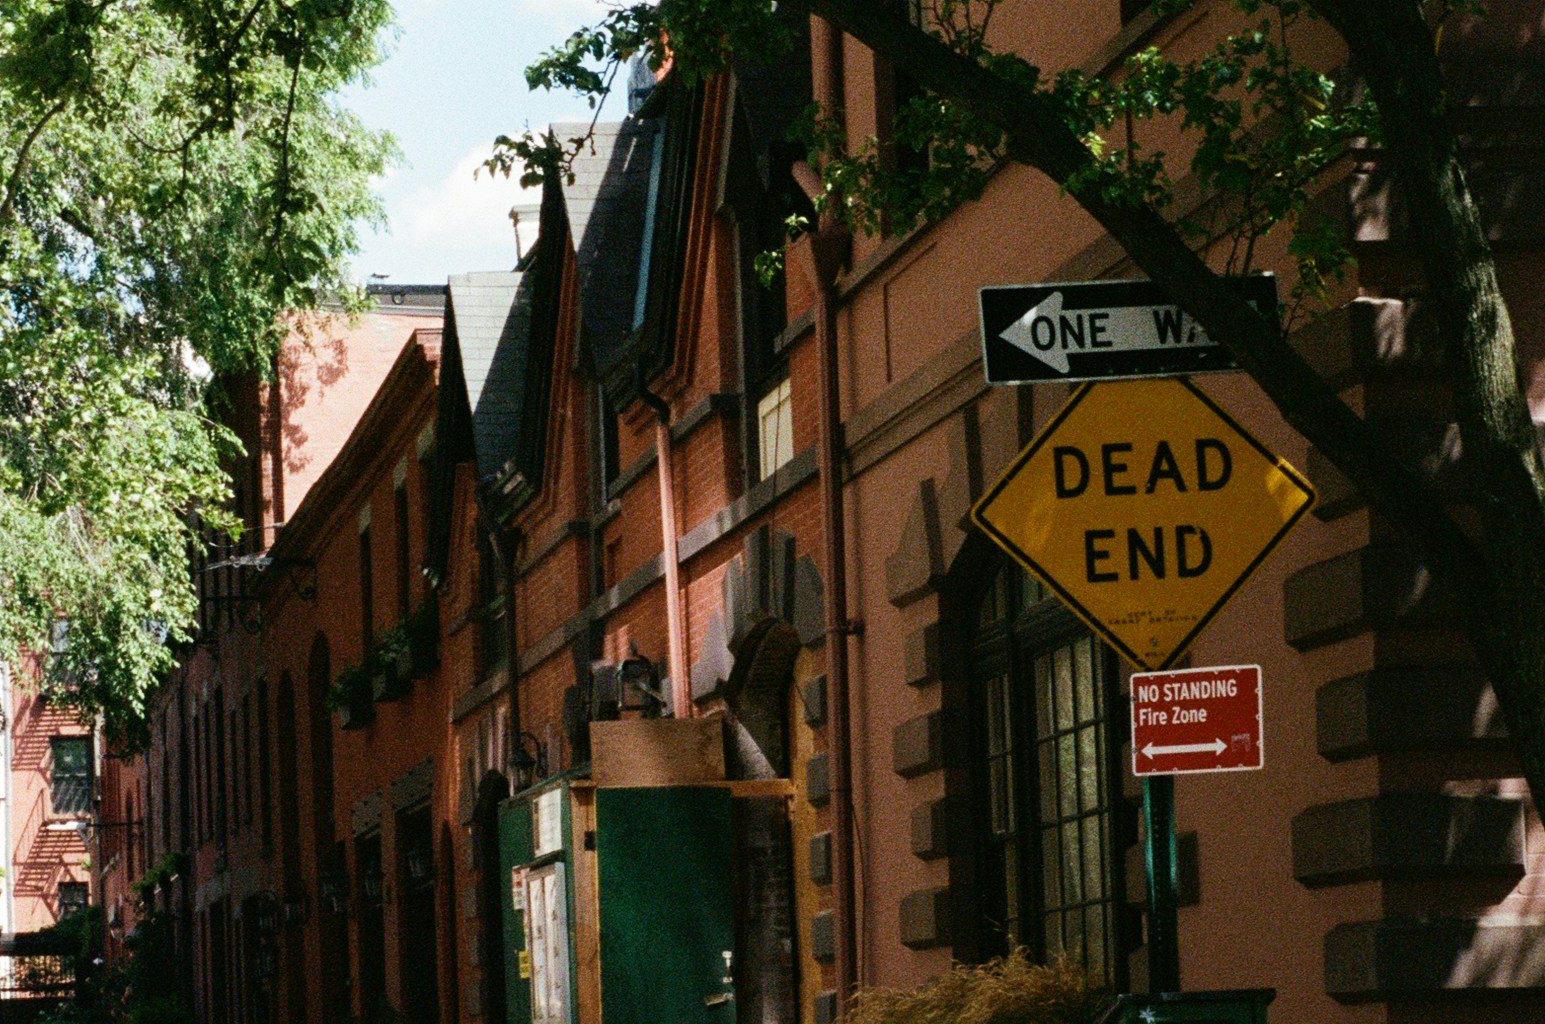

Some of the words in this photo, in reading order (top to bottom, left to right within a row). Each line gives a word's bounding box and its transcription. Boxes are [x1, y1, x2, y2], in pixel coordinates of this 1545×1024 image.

[1030, 312, 1113, 351] ONE
[1052, 438, 1233, 499] DEAD
[1084, 524, 1213, 584] END
[1138, 684, 1160, 703] NO
[1163, 678, 1238, 702] STANDING
[1139, 707, 1168, 727] Fire
[1171, 706, 1208, 725] Zone
